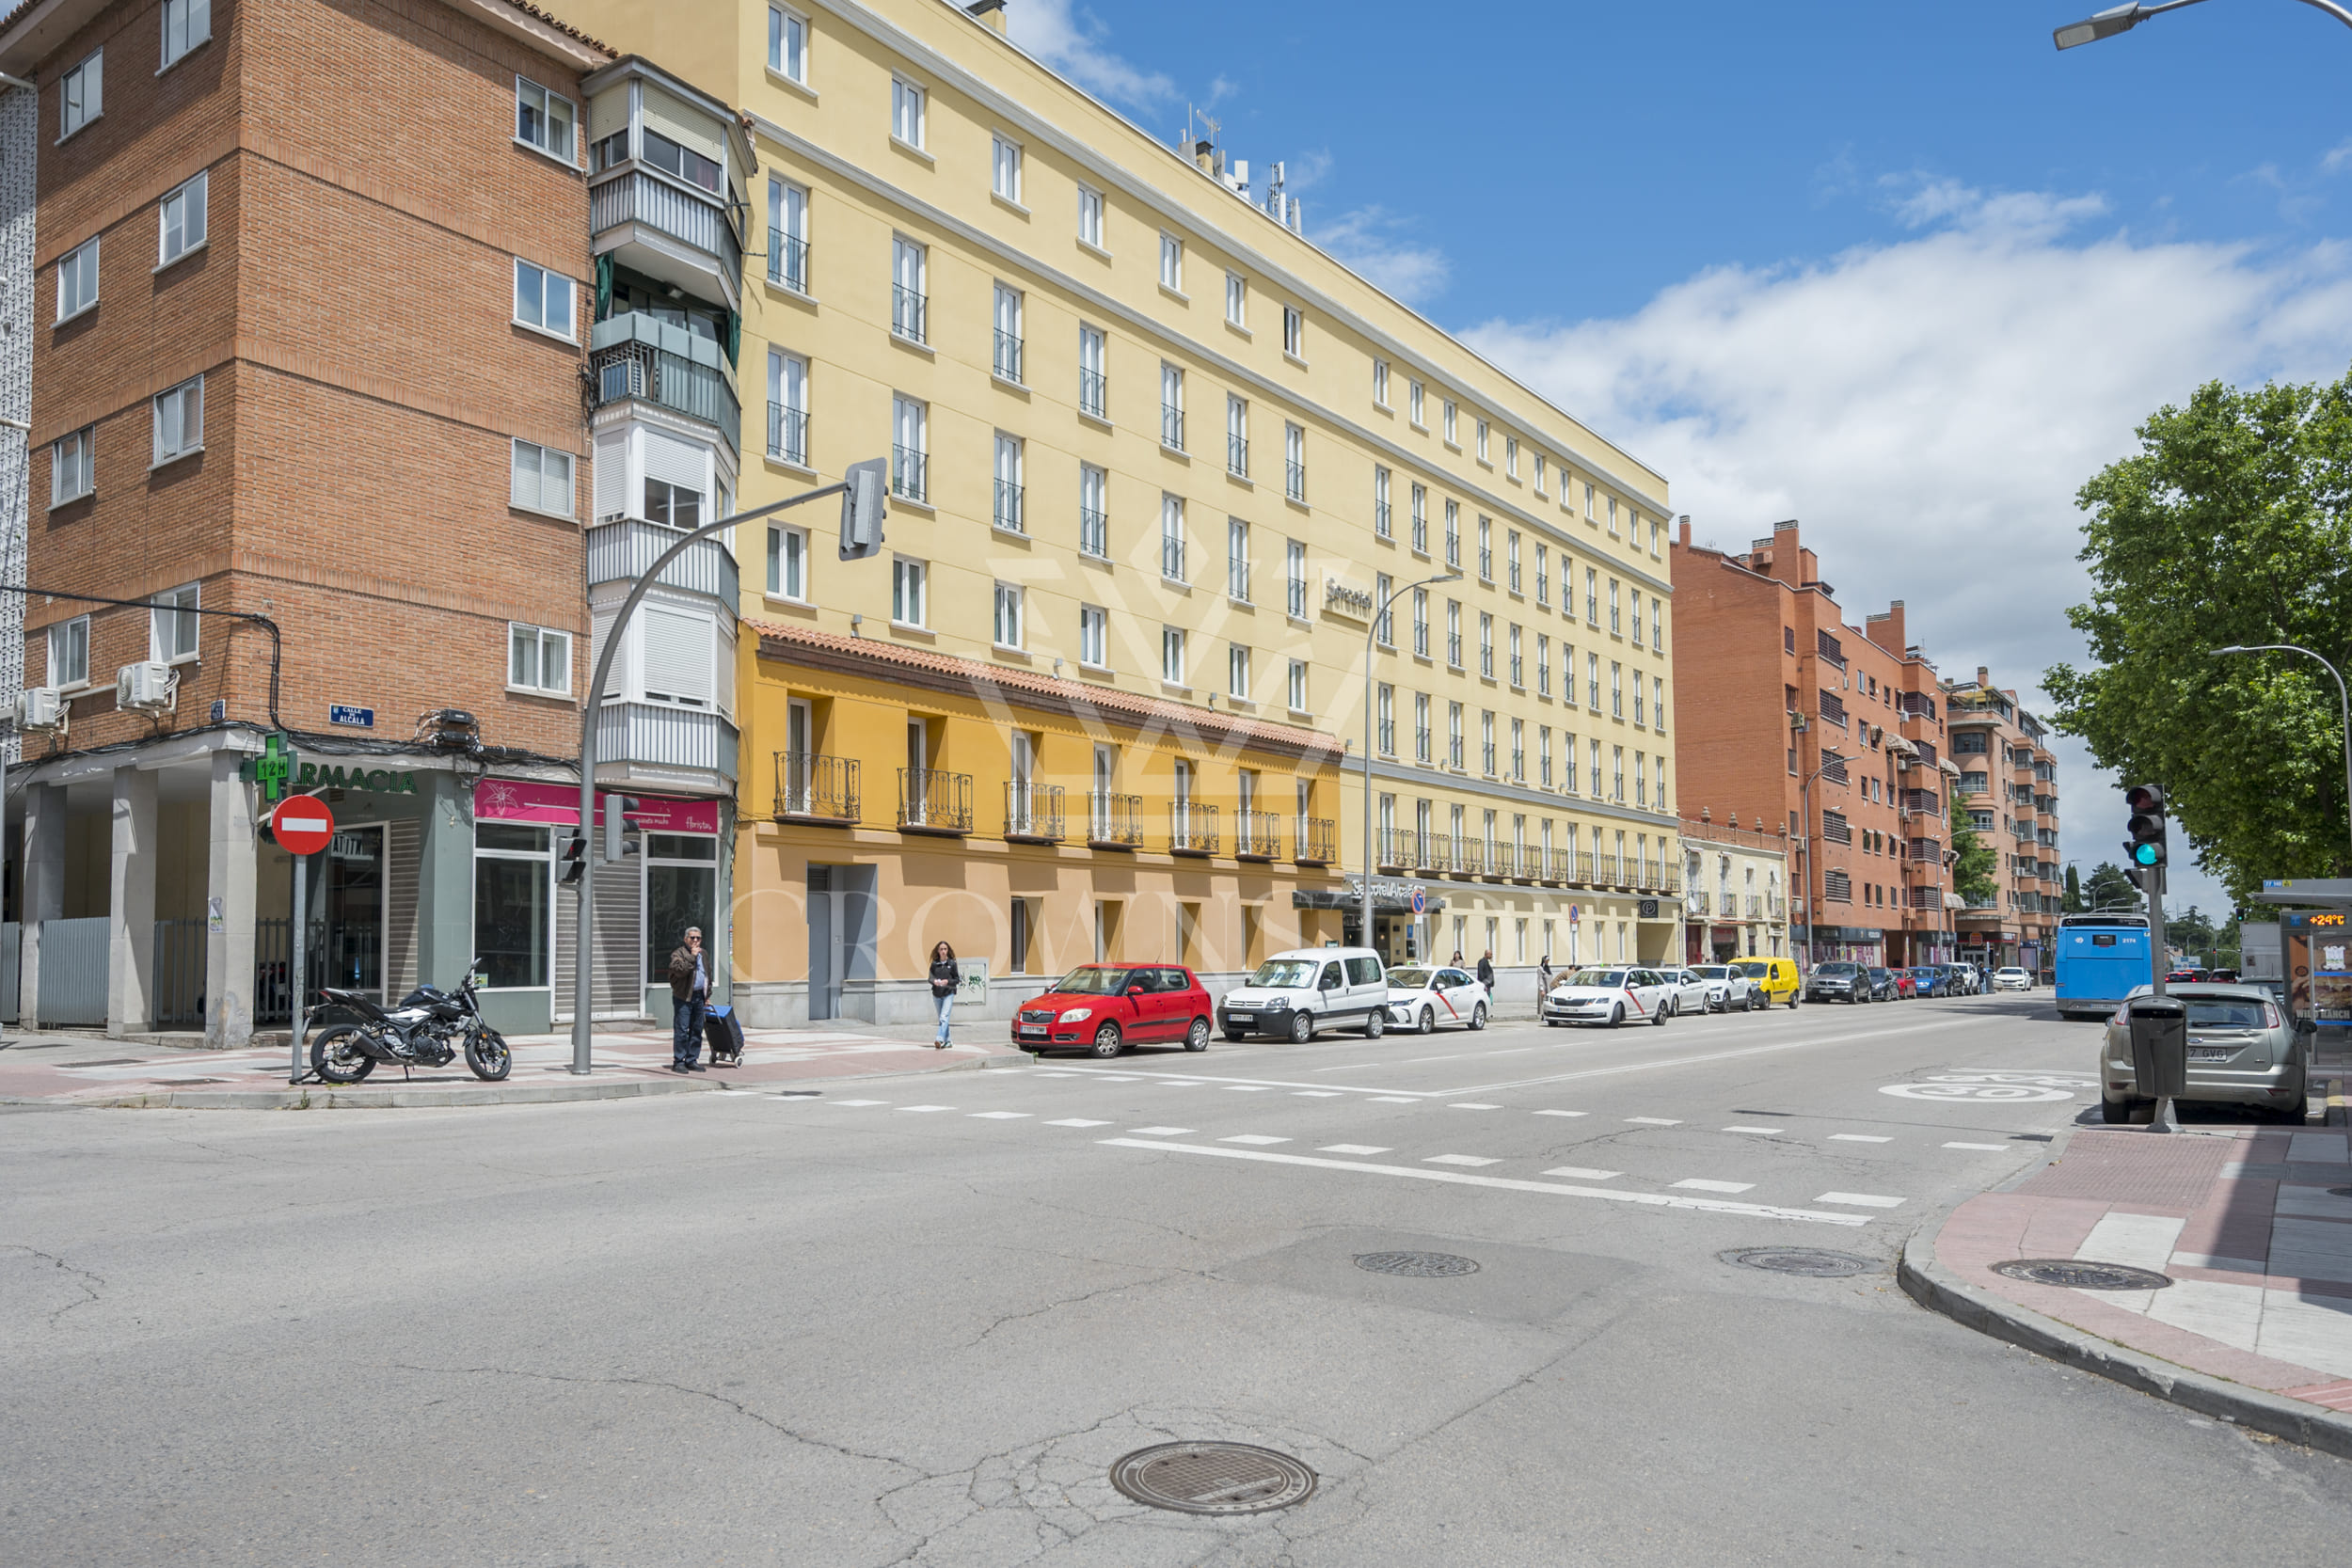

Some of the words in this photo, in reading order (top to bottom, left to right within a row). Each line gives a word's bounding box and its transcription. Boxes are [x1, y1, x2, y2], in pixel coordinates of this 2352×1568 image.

[1325, 577, 1373, 610] Sercotel
[342, 706, 362, 715] CALLE
[1921, 1086, 2029, 1098] 30
